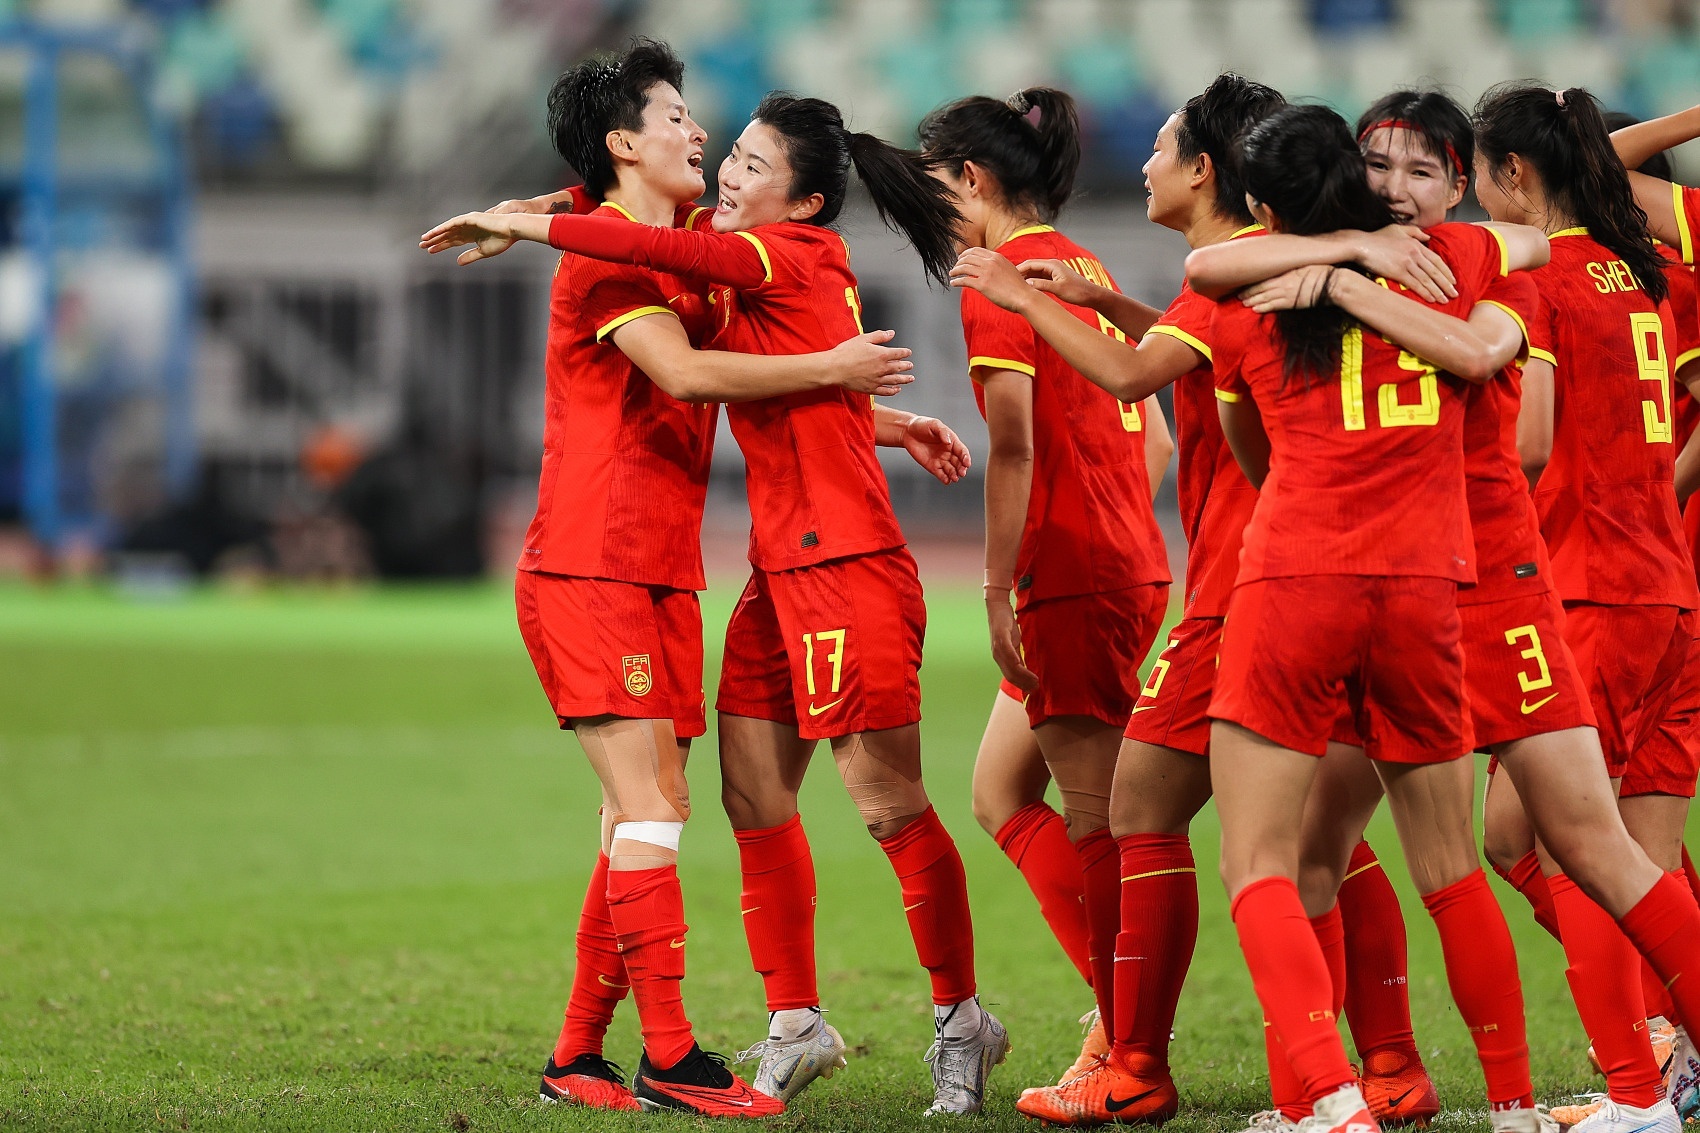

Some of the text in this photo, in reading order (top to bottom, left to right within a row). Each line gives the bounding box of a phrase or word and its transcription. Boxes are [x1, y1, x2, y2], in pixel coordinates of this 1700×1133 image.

[1629, 312, 1672, 443] 9
[624, 657, 648, 667] CFA
[802, 629, 846, 695] 17
[1141, 639, 1180, 699] 6
[1504, 624, 1553, 693] 3
